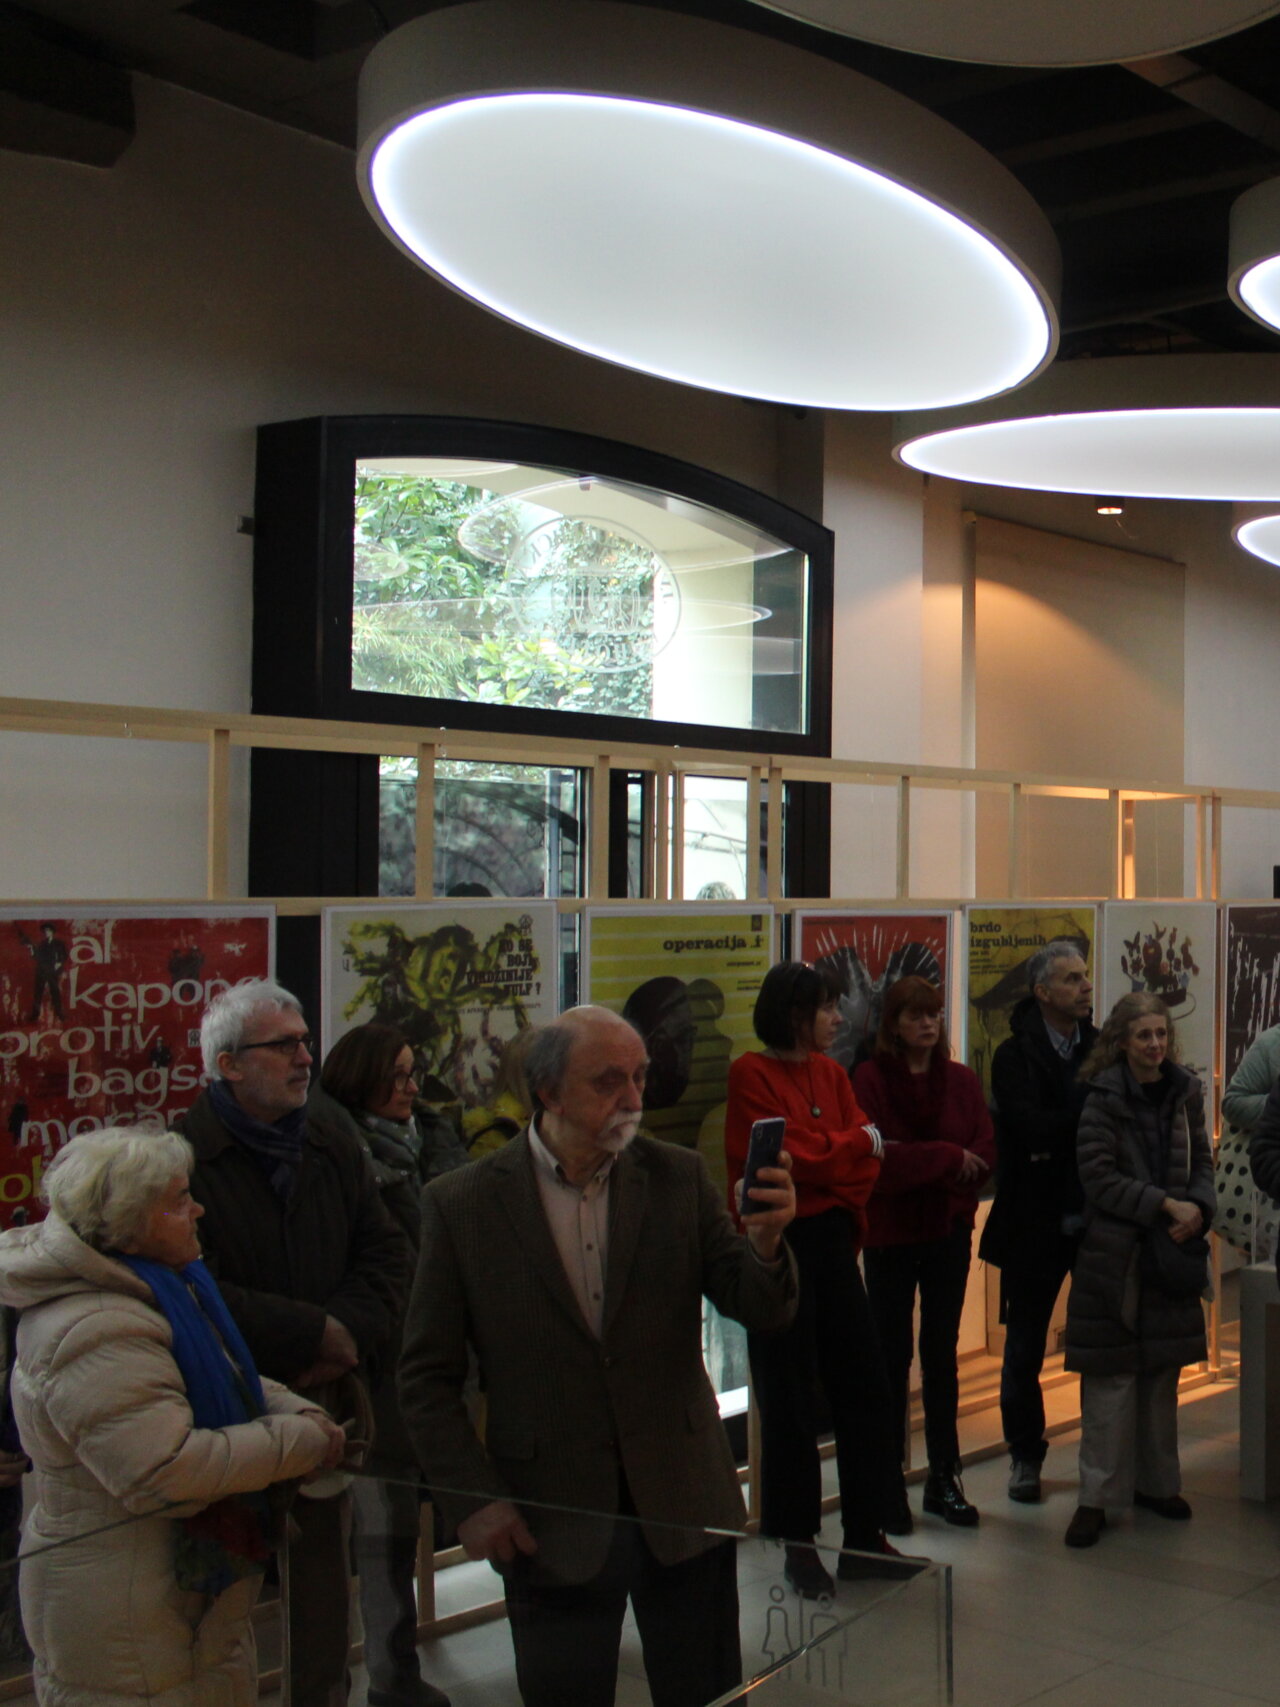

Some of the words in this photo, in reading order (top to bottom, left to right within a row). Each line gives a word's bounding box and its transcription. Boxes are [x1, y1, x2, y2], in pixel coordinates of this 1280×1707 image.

[970, 920, 1001, 933] brdo
[69, 919, 113, 965] al
[663, 935, 746, 953] operacija
